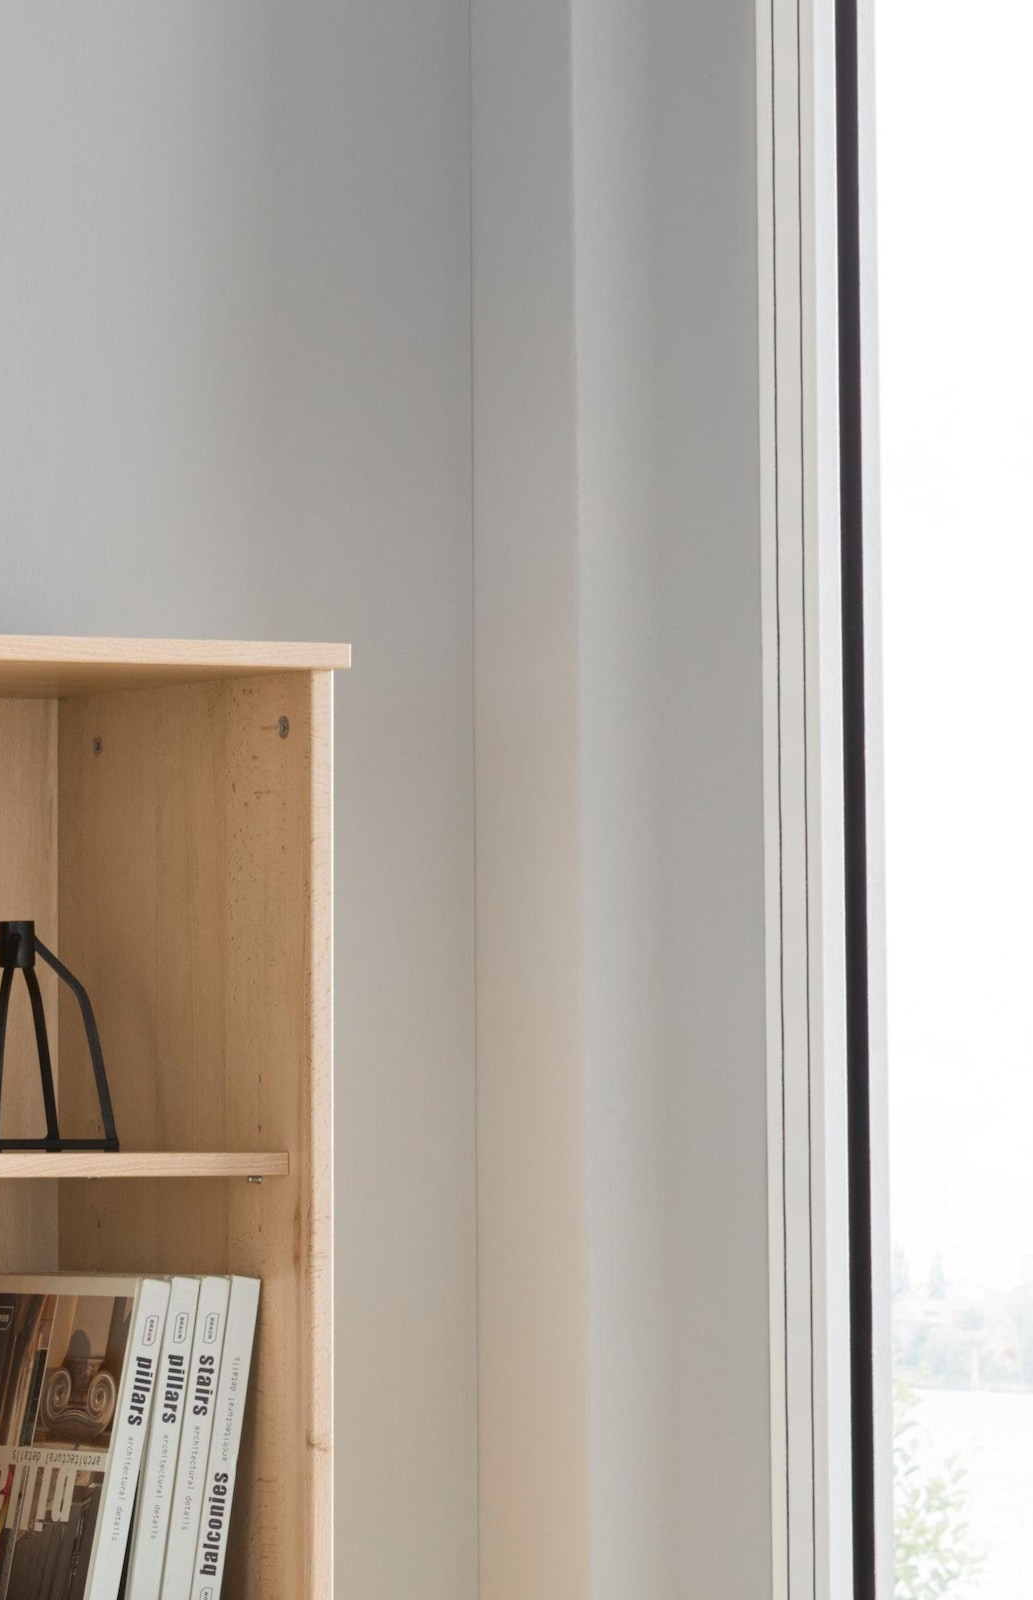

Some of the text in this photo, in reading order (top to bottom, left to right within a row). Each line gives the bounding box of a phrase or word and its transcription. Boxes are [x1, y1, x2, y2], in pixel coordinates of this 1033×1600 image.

[146, 1319, 155, 1342] BRAUN
[177, 1316, 186, 1340] BRAUN
[207, 1316, 216, 1340] BRAUN
[128, 1356, 154, 1426] pillars
[161, 1354, 186, 1424] pillars
[192, 1354, 215, 1417] stairs
[221, 1356, 241, 1462] architectural details
[12, 1449, 102, 1467] architectural details
[111, 1435, 135, 1541] architectural details
[150, 1433, 170, 1540] architectural details
[181, 1424, 201, 1531] architectural details
[199, 1471, 229, 1577] balconies
